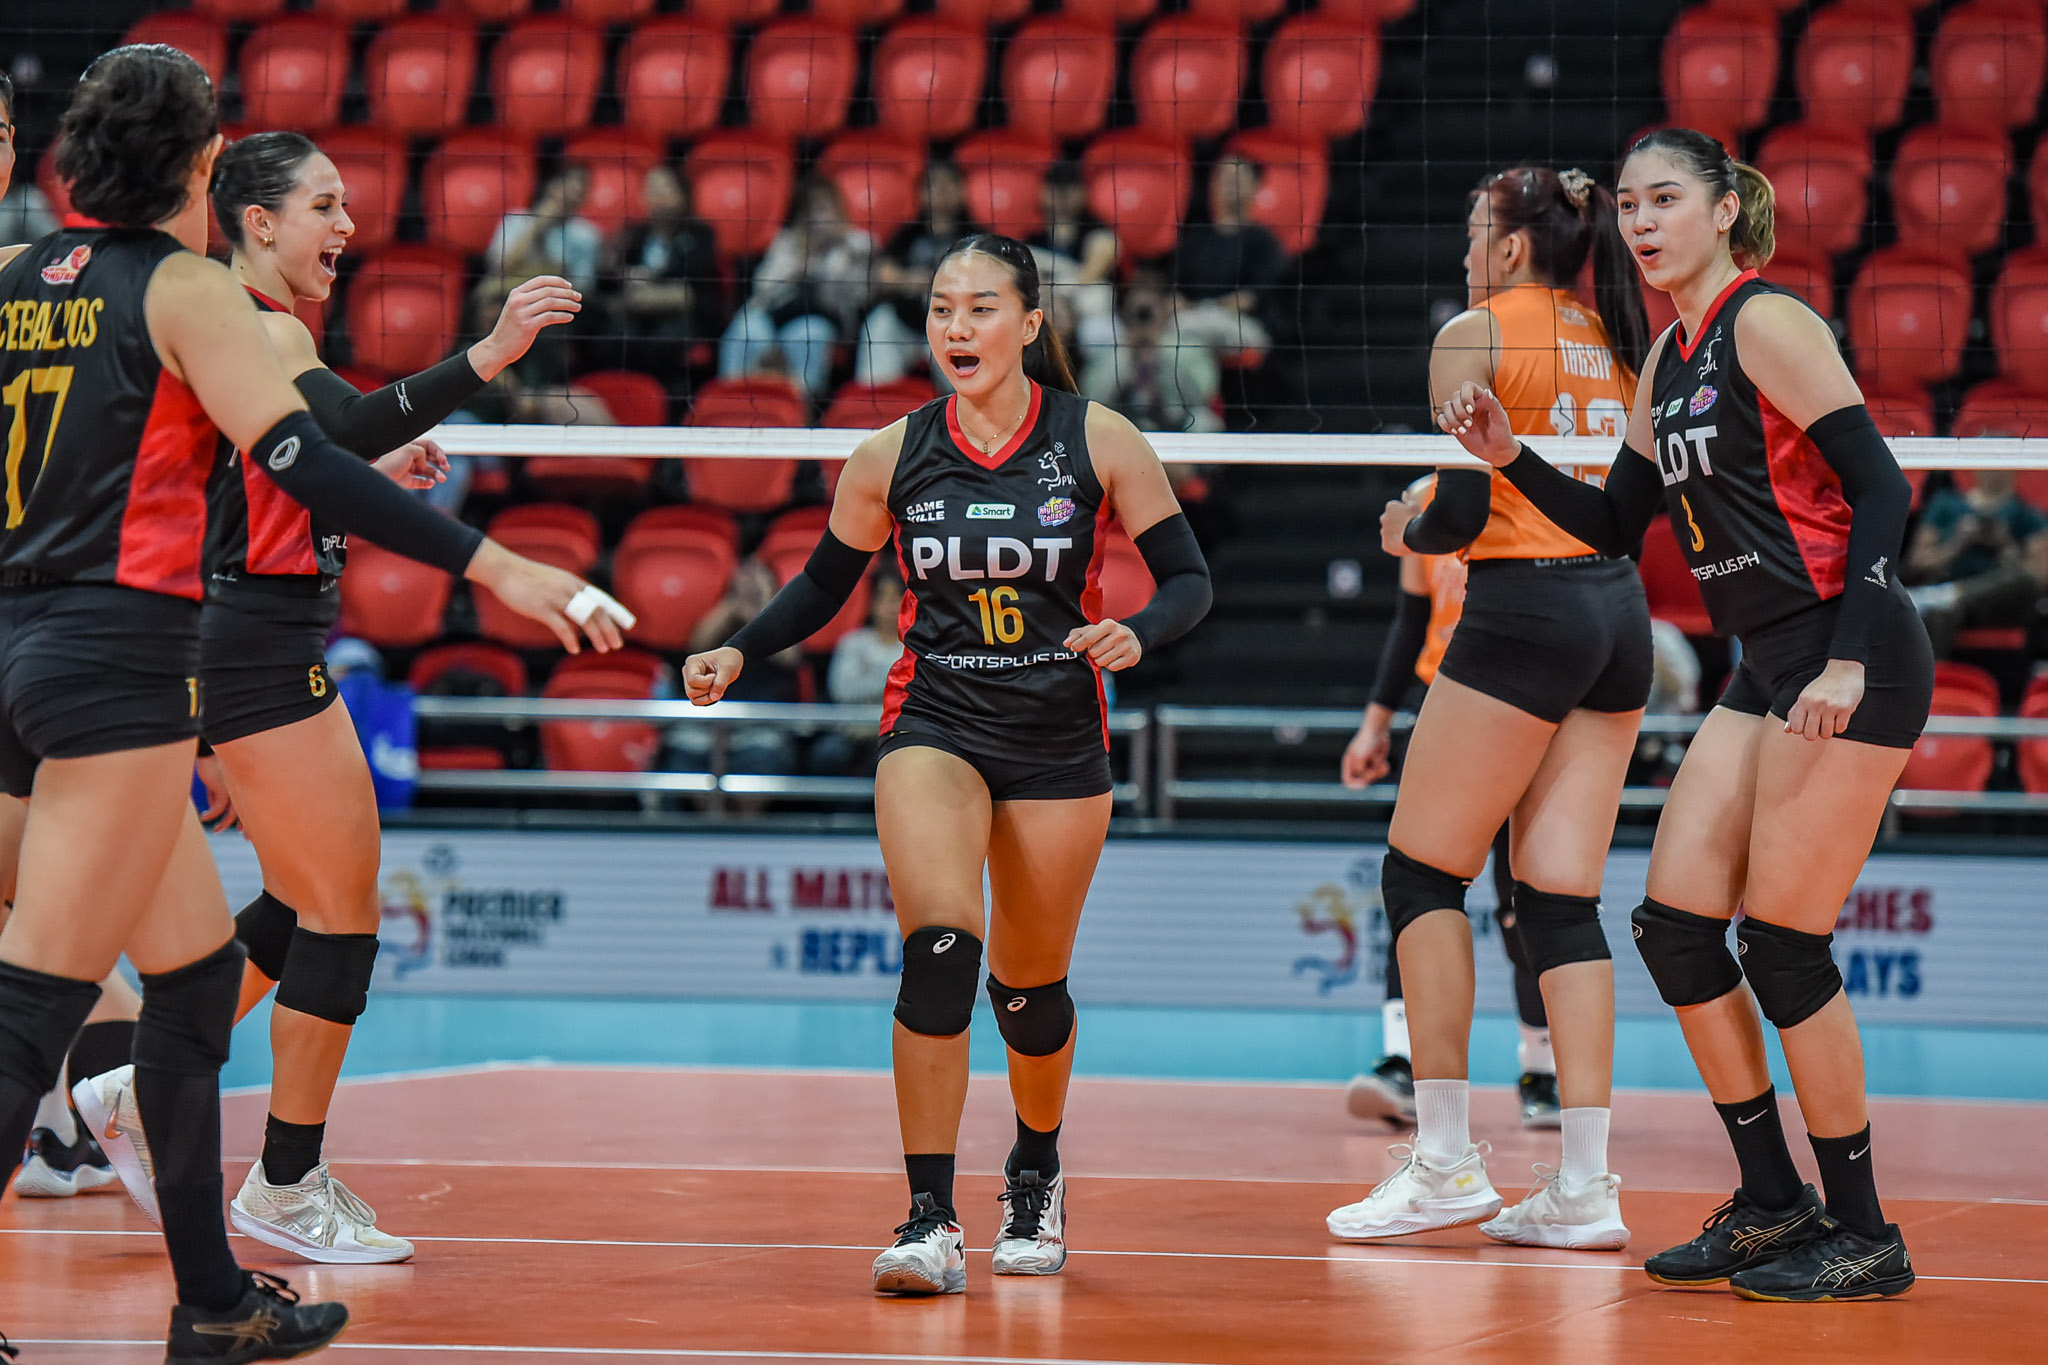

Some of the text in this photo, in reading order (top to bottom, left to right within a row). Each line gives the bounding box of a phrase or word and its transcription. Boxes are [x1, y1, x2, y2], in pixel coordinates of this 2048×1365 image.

[1558, 337, 1614, 381] TAGSIP
[2, 365, 75, 530] 17
[1653, 425, 1718, 488] LDT
[905, 499, 945, 516] GAME
[982, 507, 1011, 516] Smart
[1681, 493, 1705, 553] 3
[911, 536, 1073, 582] PLDT
[1690, 551, 1761, 581] TSPLUS.PH
[967, 585, 1025, 646] 16
[308, 664, 327, 698] 6
[713, 868, 774, 911] ALL
[1842, 949, 1922, 996] AYS
